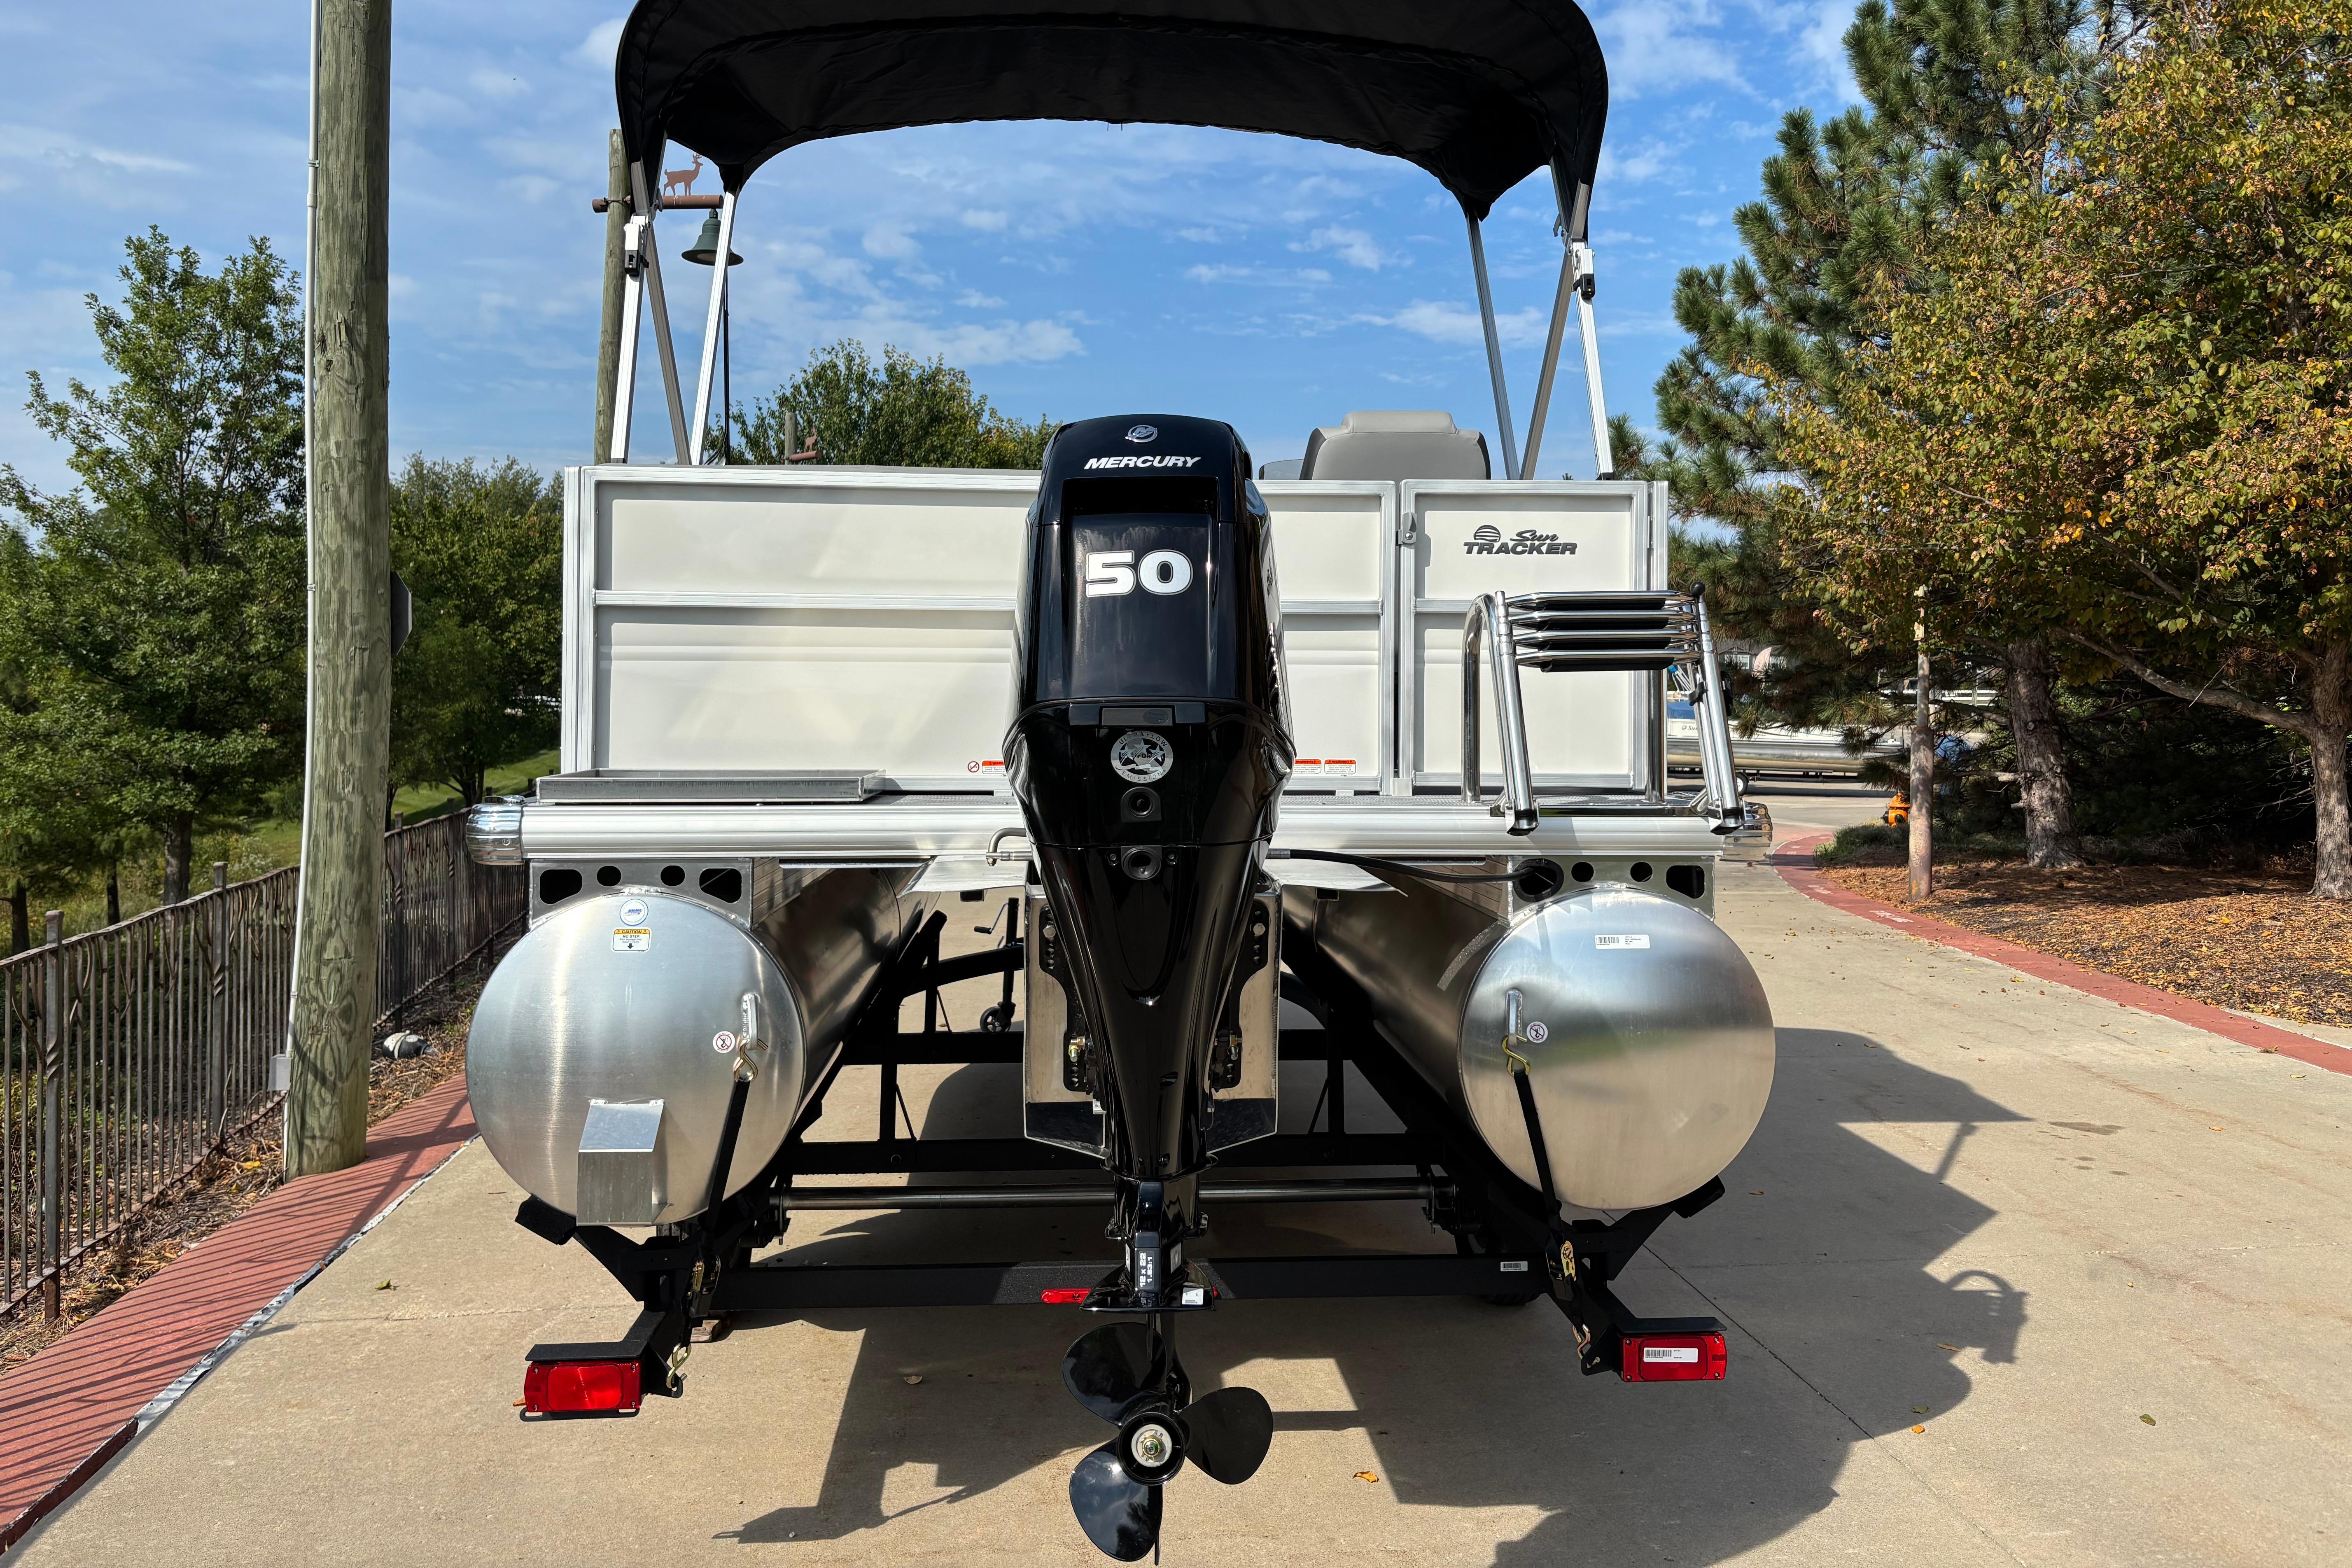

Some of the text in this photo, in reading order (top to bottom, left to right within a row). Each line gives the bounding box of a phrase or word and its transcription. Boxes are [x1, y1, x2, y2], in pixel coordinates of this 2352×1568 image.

[1084, 456, 1202, 470] MERCURY
[1510, 530, 1559, 542] Sun
[1463, 542, 1577, 555] TRACKER
[1086, 549, 1193, 597] 50
[1151, 734, 1167, 747] LOW
[1140, 1253, 1146, 1266] 22
[1139, 1276, 1146, 1288] 12
